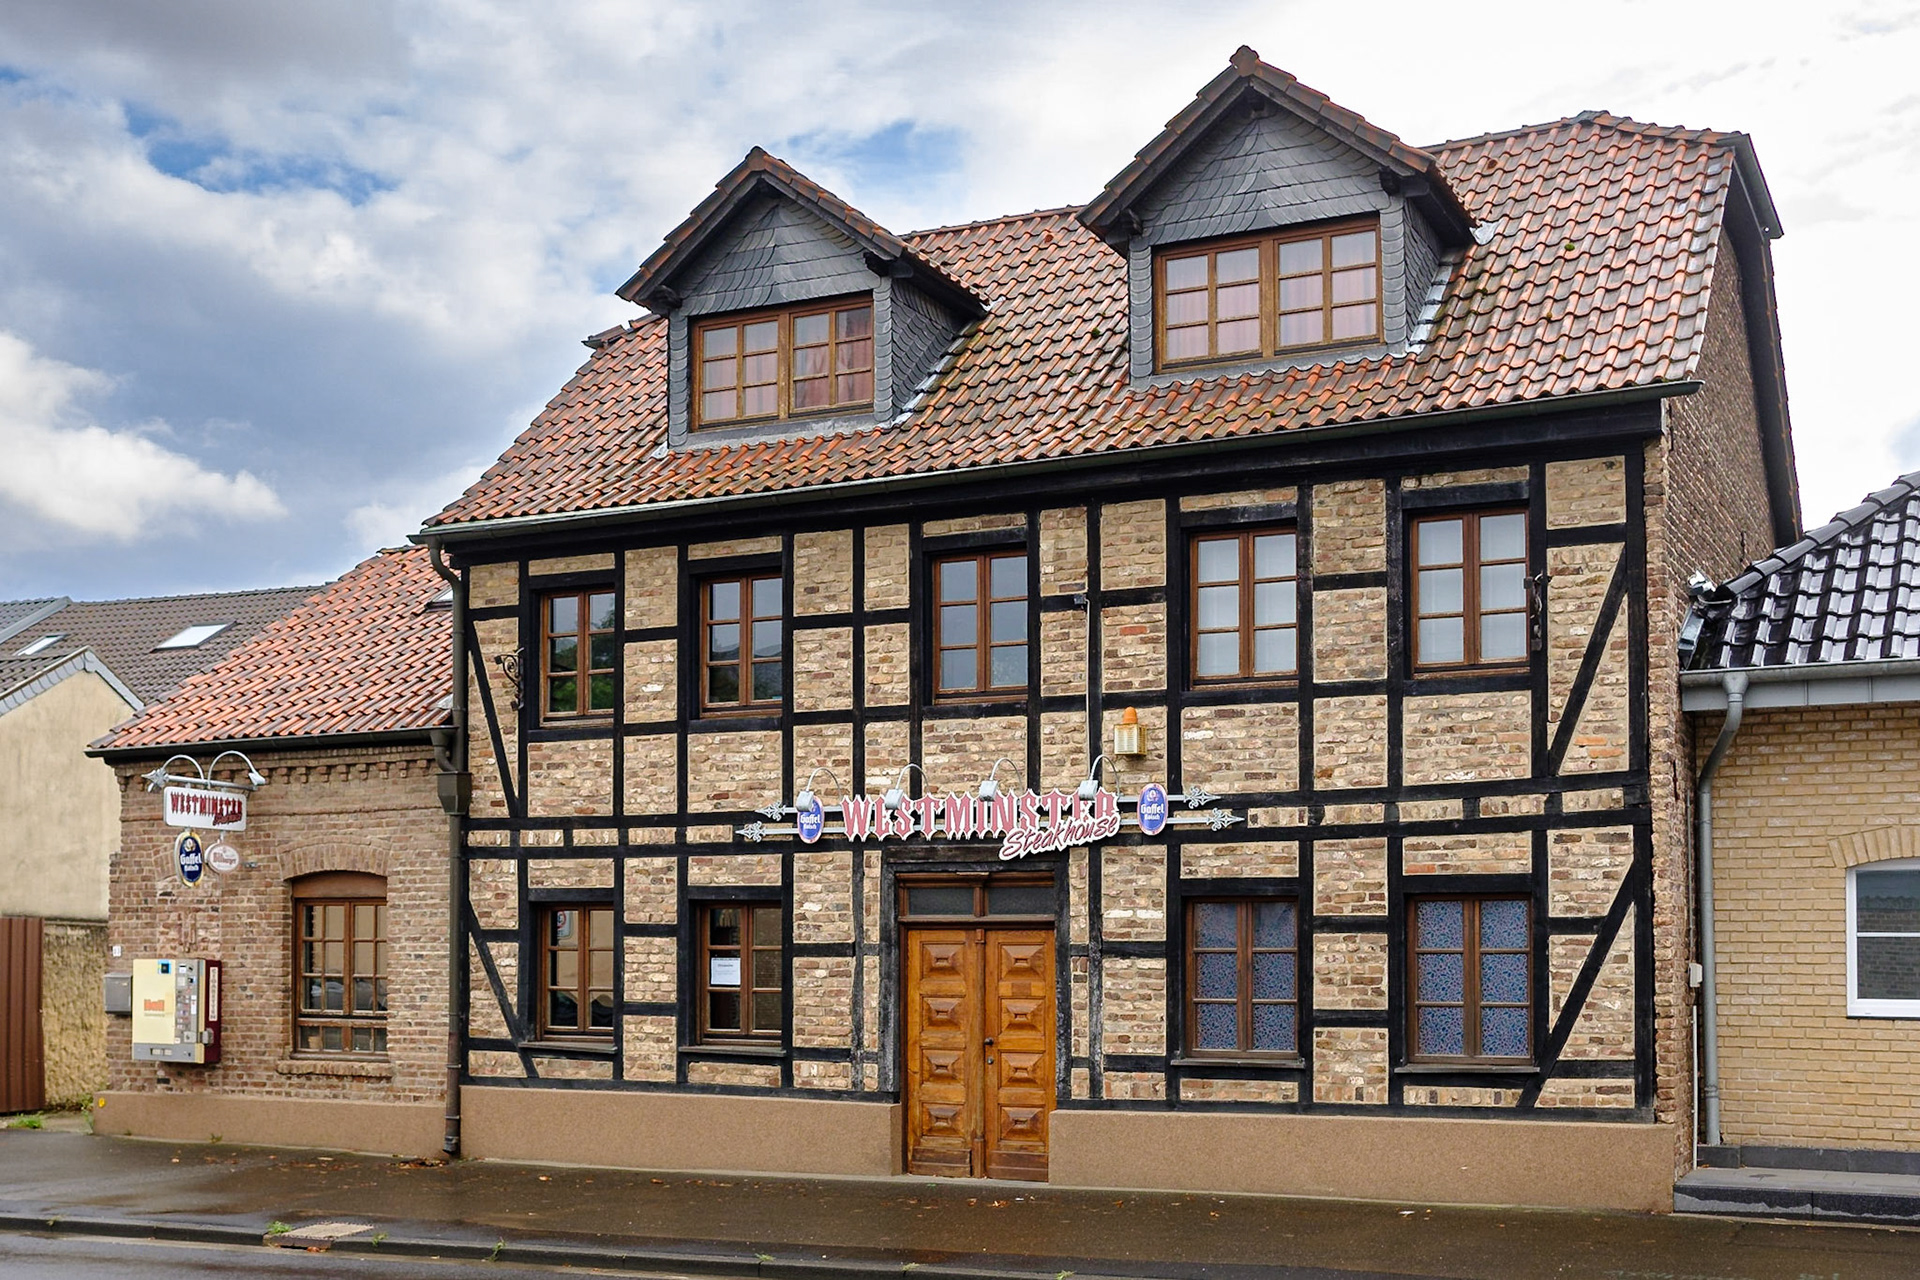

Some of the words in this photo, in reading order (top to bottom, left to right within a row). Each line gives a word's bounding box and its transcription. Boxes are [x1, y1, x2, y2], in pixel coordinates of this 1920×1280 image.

[841, 787, 1119, 842] WESTMINSTER
[1140, 803, 1165, 815] Gaffel
[800, 814, 821, 824] Gaffel
[1000, 814, 1119, 860] Steakhouse
[180, 853, 203, 866] Gaffel
